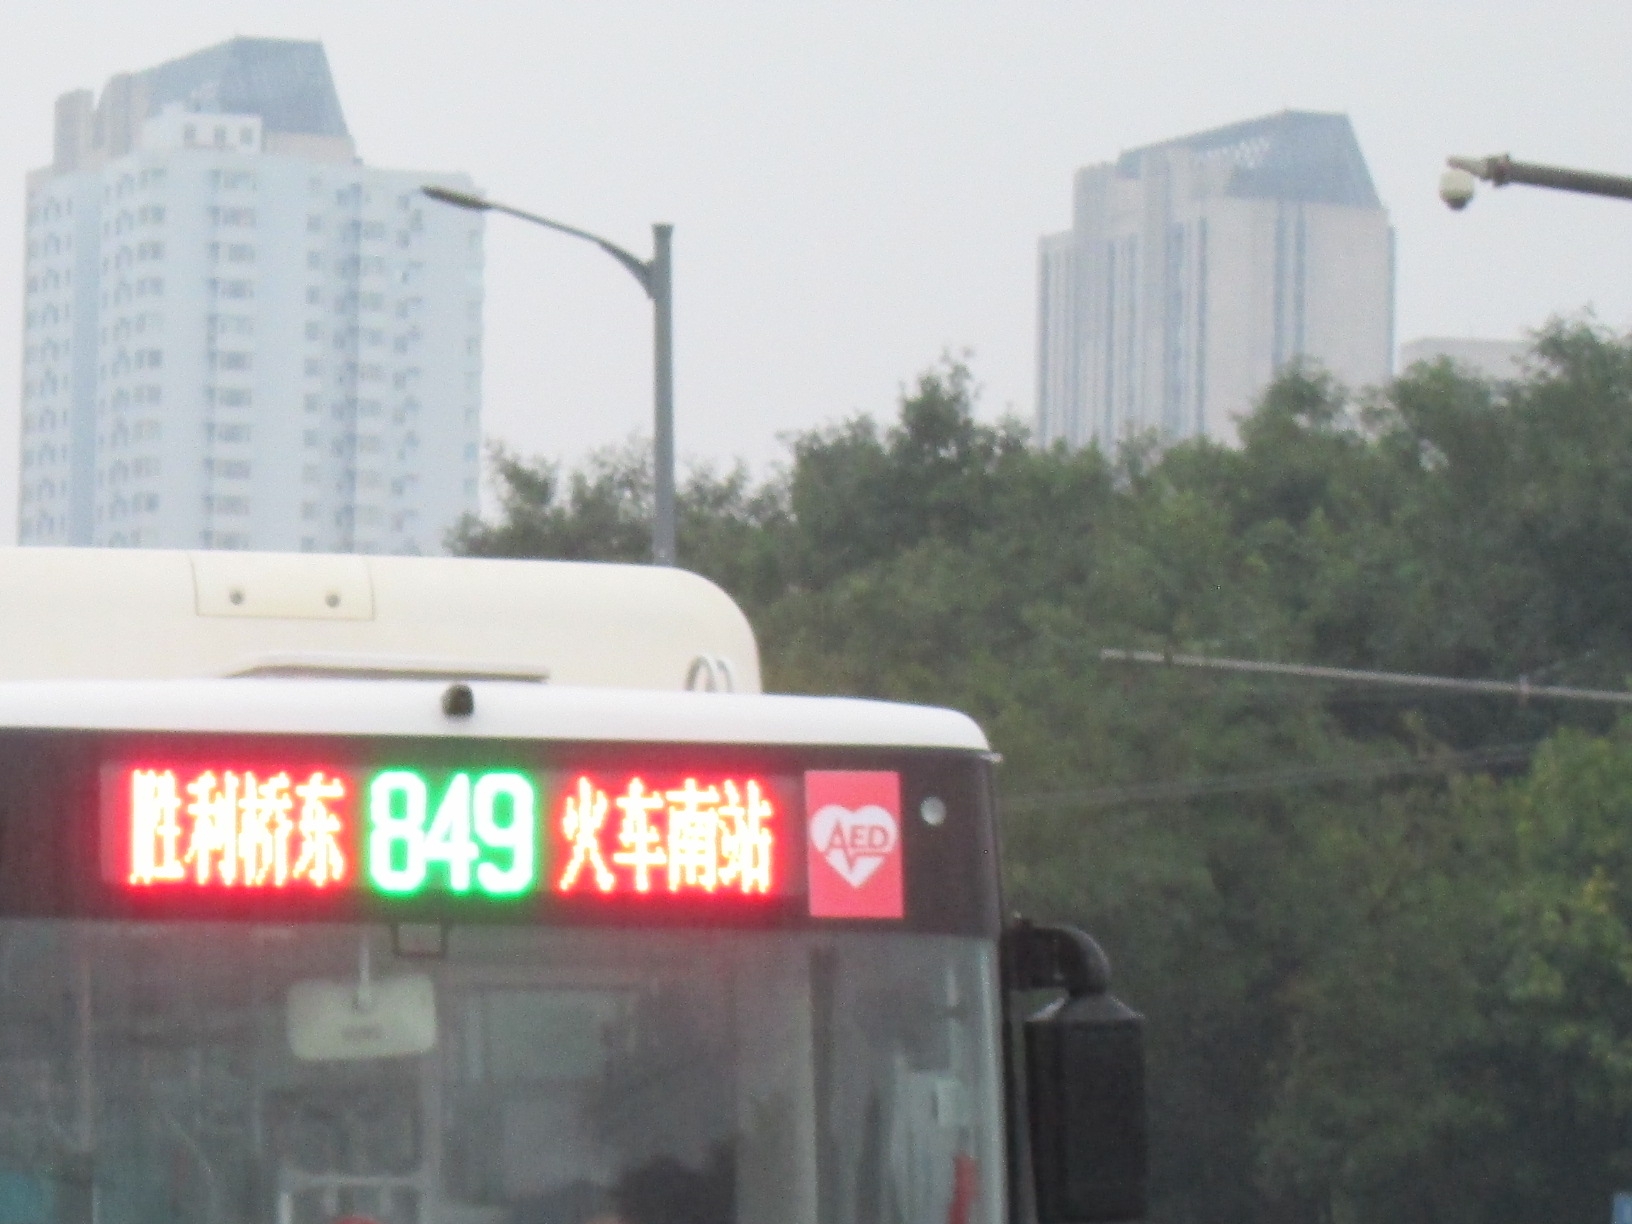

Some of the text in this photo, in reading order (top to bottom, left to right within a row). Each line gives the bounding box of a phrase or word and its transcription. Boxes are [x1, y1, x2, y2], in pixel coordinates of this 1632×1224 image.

[128, 768, 772, 893] 胜利桥东 849 火车南站
[829, 823, 891, 850] AED
